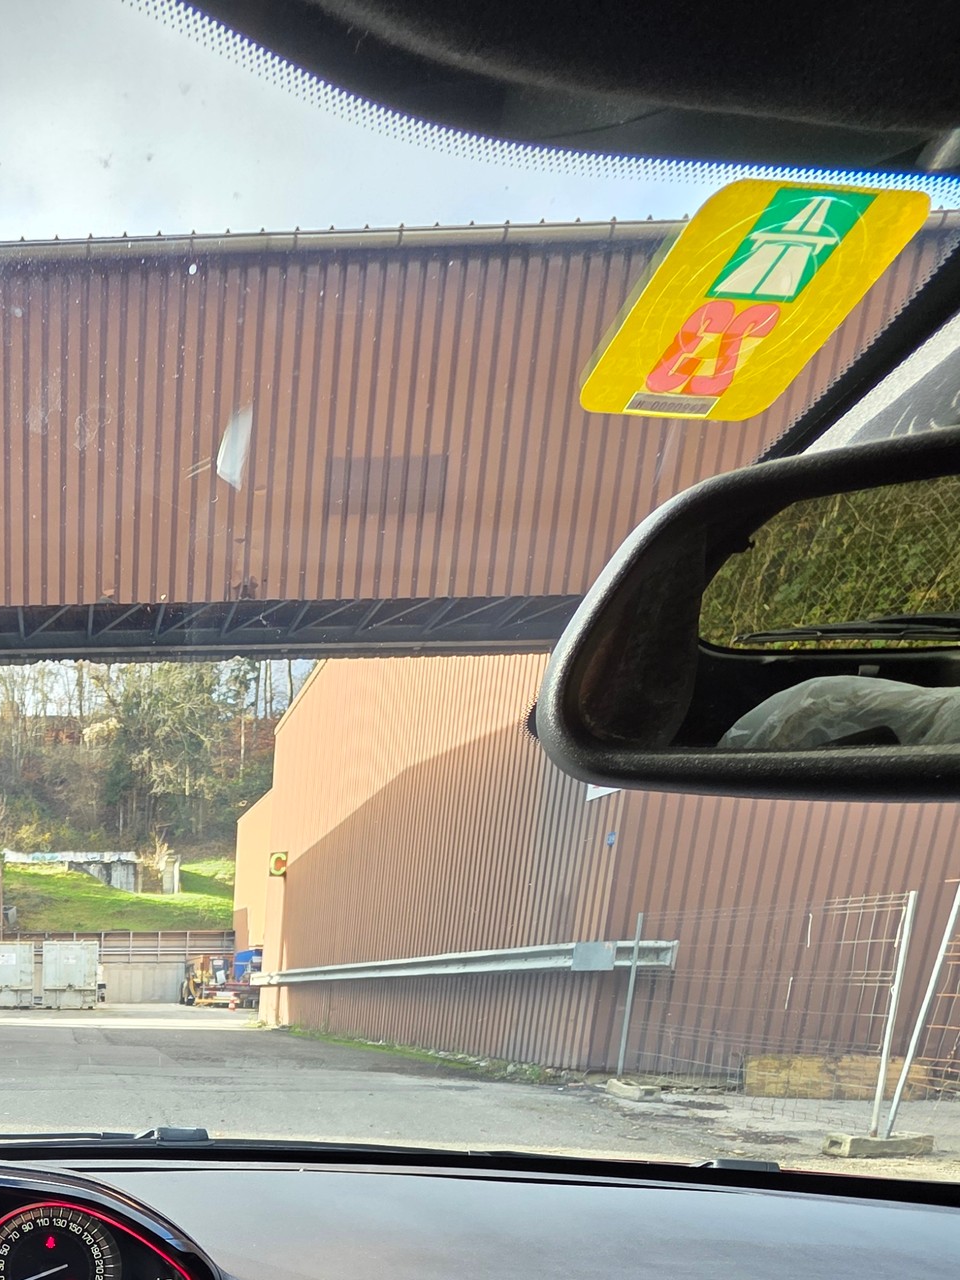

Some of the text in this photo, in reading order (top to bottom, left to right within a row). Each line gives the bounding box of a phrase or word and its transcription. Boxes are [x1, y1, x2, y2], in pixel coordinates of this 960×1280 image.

[270, 853, 287, 876] C
[22, 1222, 33, 1232] 90
[36, 1218, 50, 1226] 110
[52, 1219, 67, 1227] 130
[69, 1223, 83, 1234] 150
[8, 1231, 20, 1242] 70
[82, 1232, 94, 1245] 170
[0, 1244, 10, 1256] 50
[90, 1244, 102, 1259] 190
[95, 1260, 104, 1274] 210
